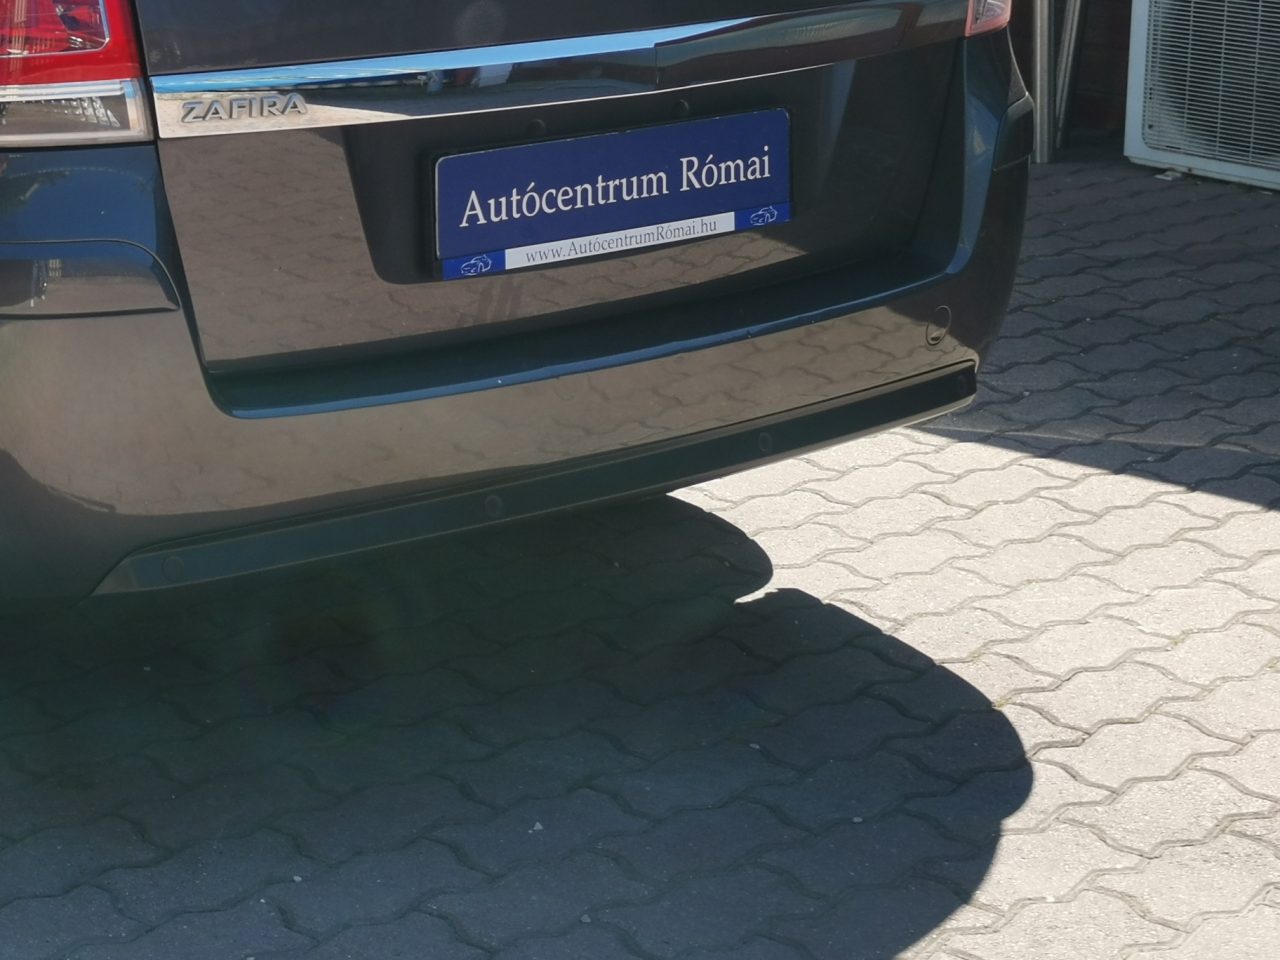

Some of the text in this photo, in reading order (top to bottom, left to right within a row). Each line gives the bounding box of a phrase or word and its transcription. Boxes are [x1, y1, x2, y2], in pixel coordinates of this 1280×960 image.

[182, 92, 307, 123] ZAFIRA
[459, 145, 770, 228] Autócentrum Római
[525, 218, 717, 265] www.AutócentrumRómai.hu
